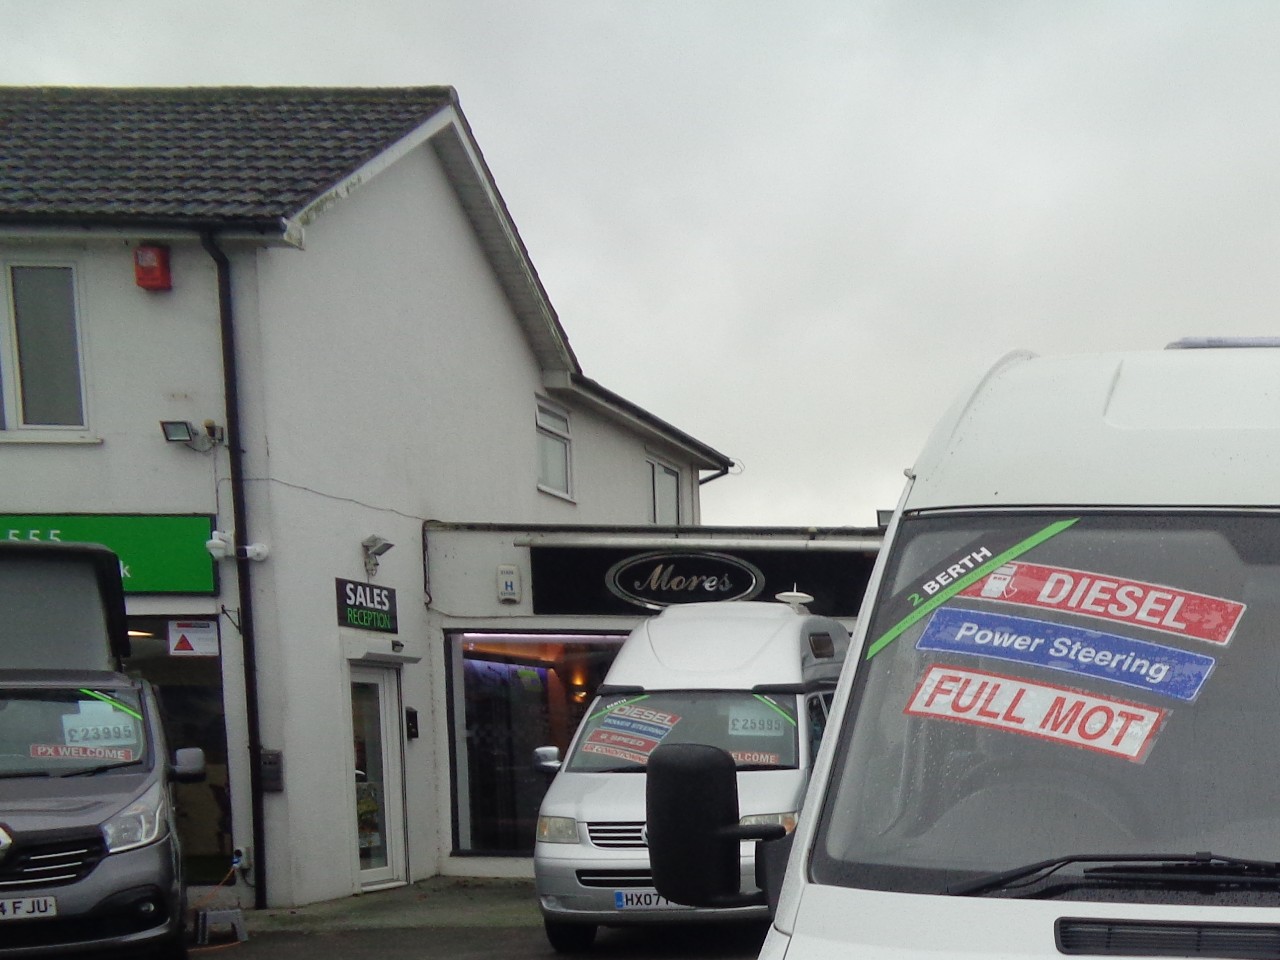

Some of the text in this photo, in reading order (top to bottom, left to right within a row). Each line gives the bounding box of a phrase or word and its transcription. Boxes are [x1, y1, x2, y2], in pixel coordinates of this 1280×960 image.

[634, 563, 732, 591] Mores
[907, 547, 992, 607] 2 BERTH
[346, 583, 390, 611] SALES
[1038, 572, 1187, 630] DIESEL
[347, 608, 391, 628] RECEPTION
[955, 622, 1170, 684] Power Steering
[613, 704, 674, 725] DIESEL
[731, 718, 781, 732] £25995
[924, 674, 1145, 748] FULL MOT
[67, 725, 132, 743] £23995
[37, 746, 125, 759] PX WELCOME
